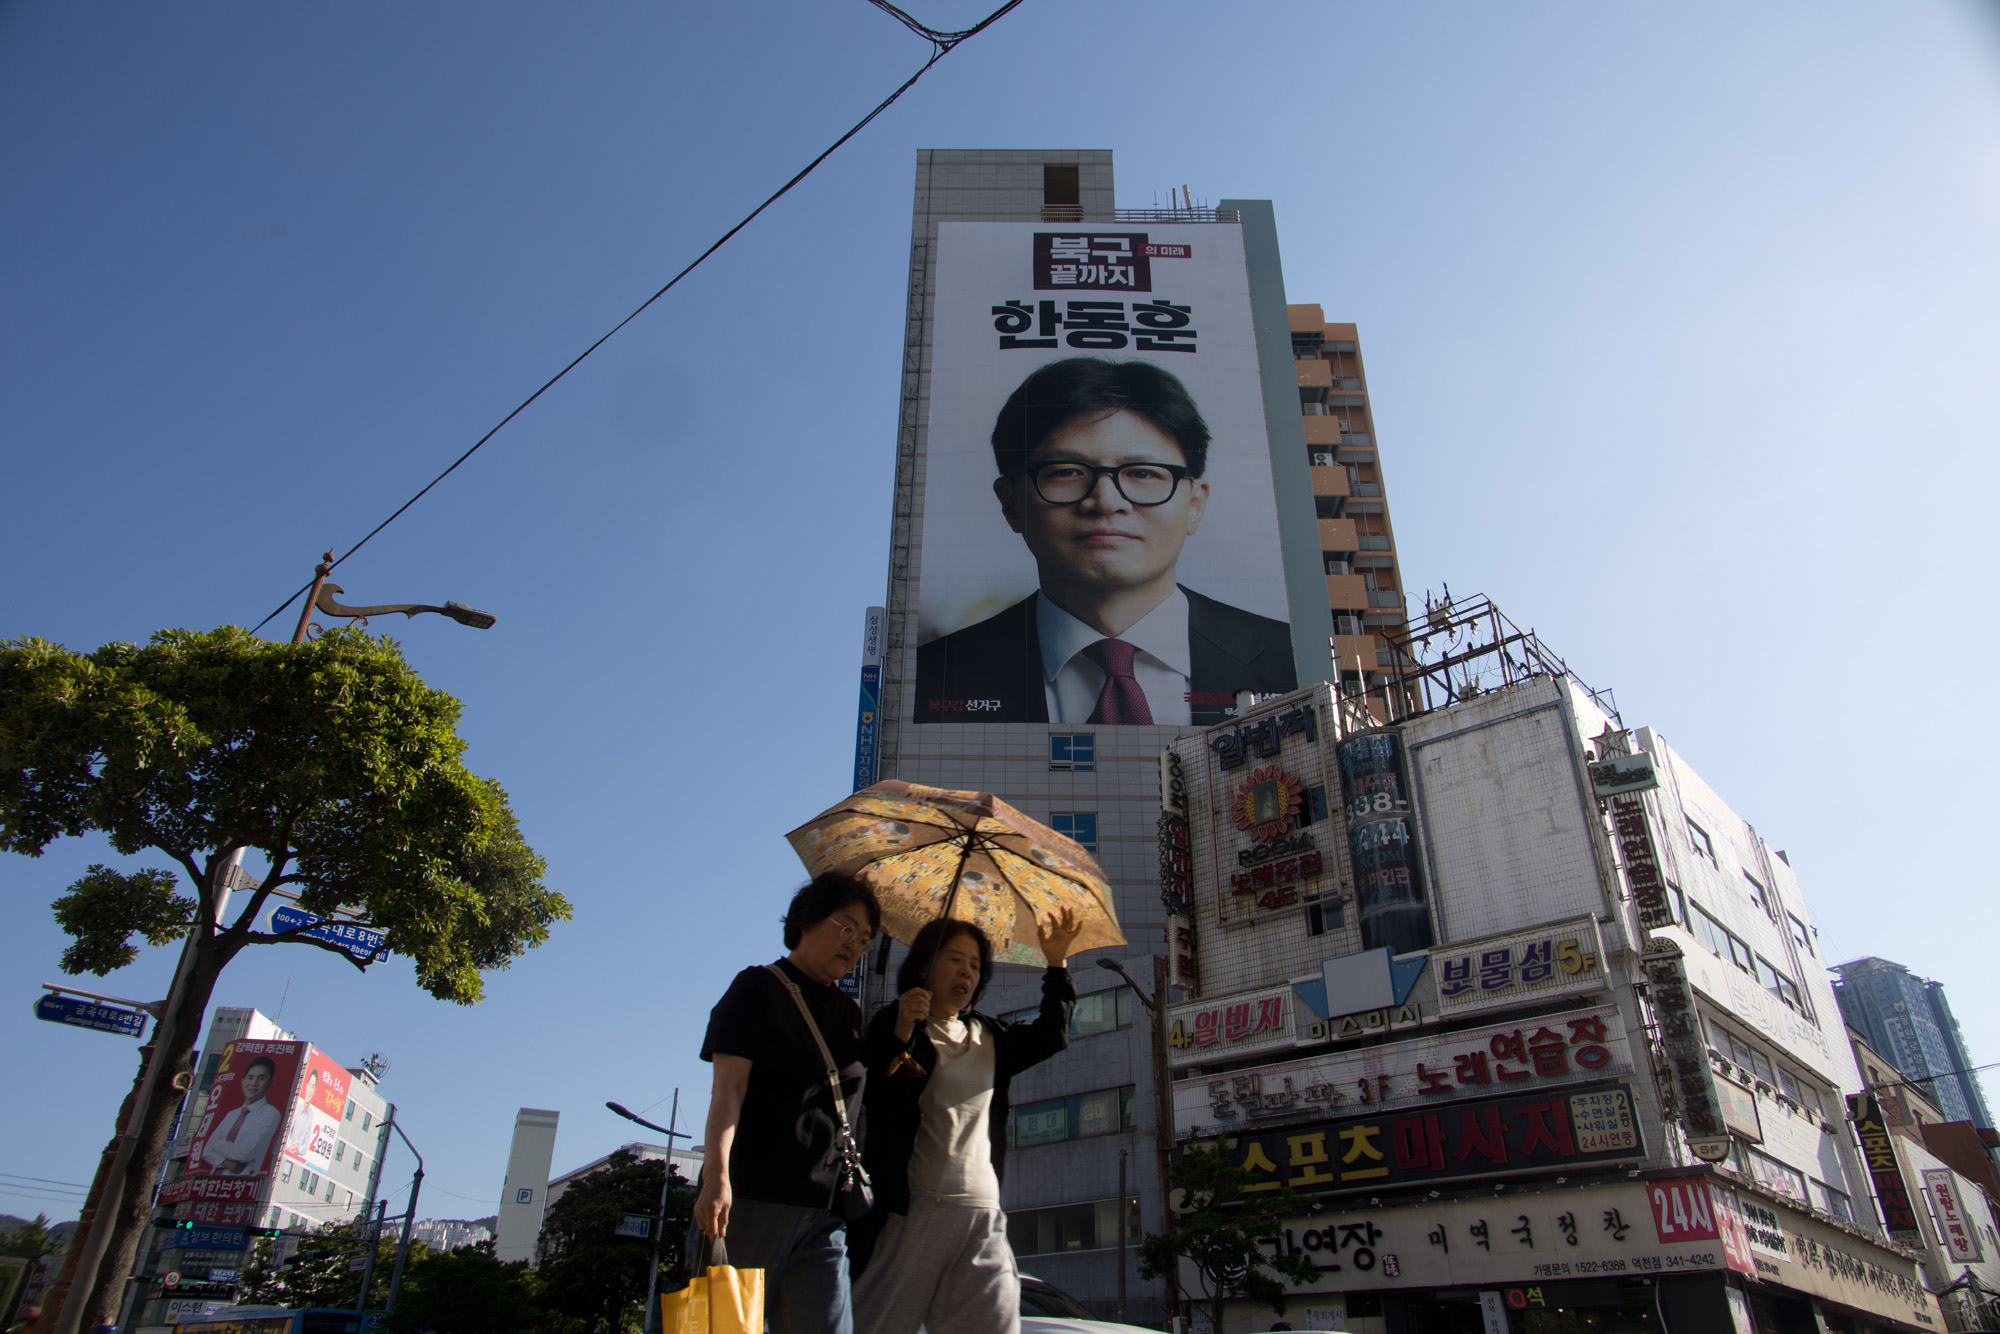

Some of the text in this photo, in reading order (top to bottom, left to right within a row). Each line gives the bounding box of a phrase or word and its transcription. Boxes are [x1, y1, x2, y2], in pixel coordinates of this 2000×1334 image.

[1050, 237, 1185, 264] 북구 의 미래
[1050, 264, 1136, 286] 끝까지
[991, 300, 1197, 353] 한동훈
[867, 615, 879, 656] 삼성생명
[965, 699, 1002, 711] 선거구
[1212, 704, 1316, 771] 일번지
[1170, 823, 1189, 904] 일번지
[1238, 832, 1315, 868] ROOM
[1613, 797, 1664, 908] 노래연습장
[1231, 851, 1323, 896] 노래주점
[1258, 886, 1298, 909] 4F
[276, 913, 291, 923] 100
[1441, 938, 1597, 996] 보물섬 5F
[75, 1004, 143, 1027] 금곡대로8번길
[1167, 996, 1284, 1050] 4F 일번지
[1308, 1003, 1423, 1043] 미스미시
[218, 1042, 295, 1074] 2 강력한 추진력
[1357, 1075, 1392, 1105] 3F
[1416, 1015, 1612, 1095] 노래연습장
[1083, 1102, 1106, 1120] 임대
[1577, 1093, 1613, 1107] 주차장
[1579, 1106, 1616, 1120] 수면실
[189, 1085, 223, 1170] 오태원
[309, 1124, 320, 1153] 2
[1581, 1118, 1618, 1132] 샤워실
[1581, 1131, 1633, 1149] 24시연중
[192, 1178, 259, 1199] 대한보청기
[195, 1202, 257, 1223] 대한 보청기
[1654, 1182, 1714, 1236] 24시
[1935, 1183, 1969, 1253] 원탑노래방
[1533, 1253, 1716, 1276] 가맹문의 1522-6388 덕천점 341-4242
[167, 1274, 178, 1284] 50
[171, 1302, 203, 1314] 이스턴
